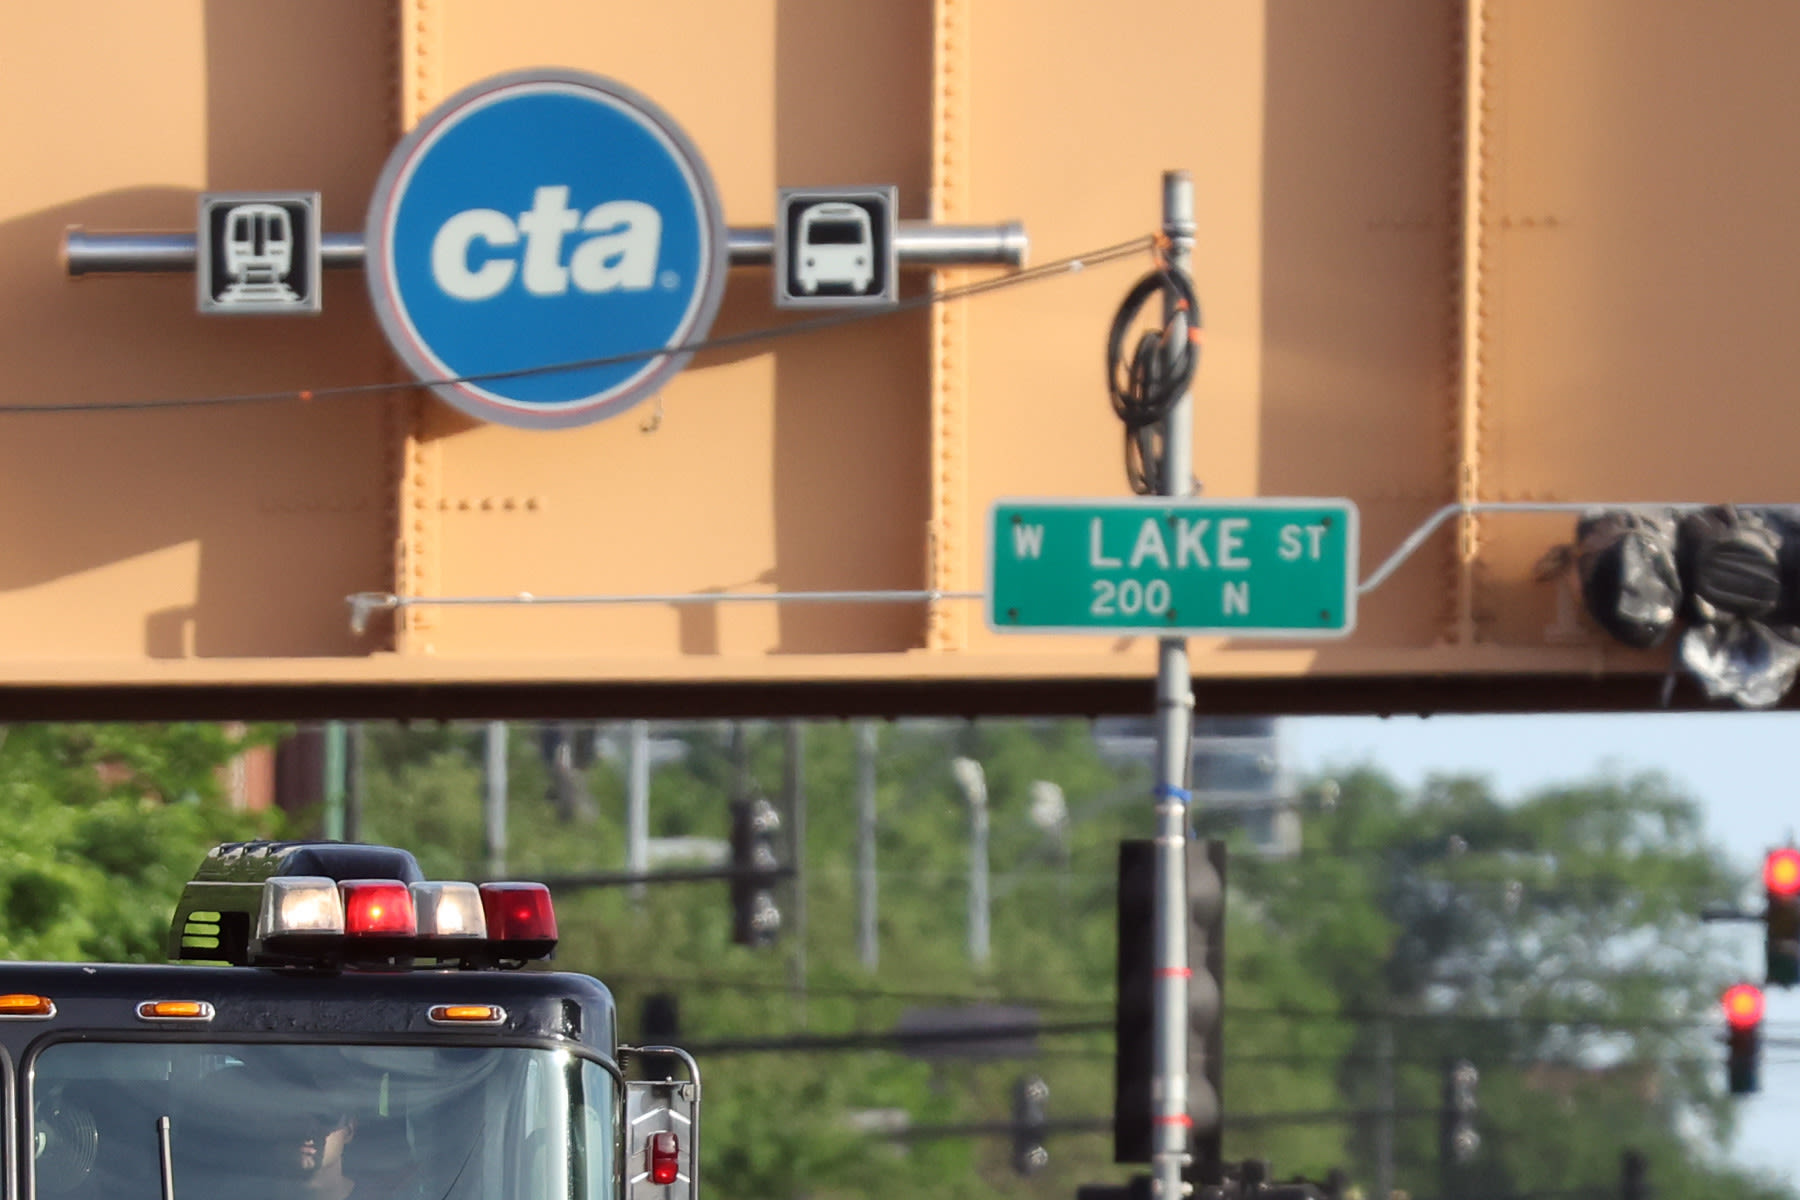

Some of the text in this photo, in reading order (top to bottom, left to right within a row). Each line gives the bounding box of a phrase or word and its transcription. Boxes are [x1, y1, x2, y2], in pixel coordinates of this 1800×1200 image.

[432, 184, 662, 301] cta
[1015, 517, 1327, 569] W LAKE ST
[1089, 579, 1250, 615] 200 N
